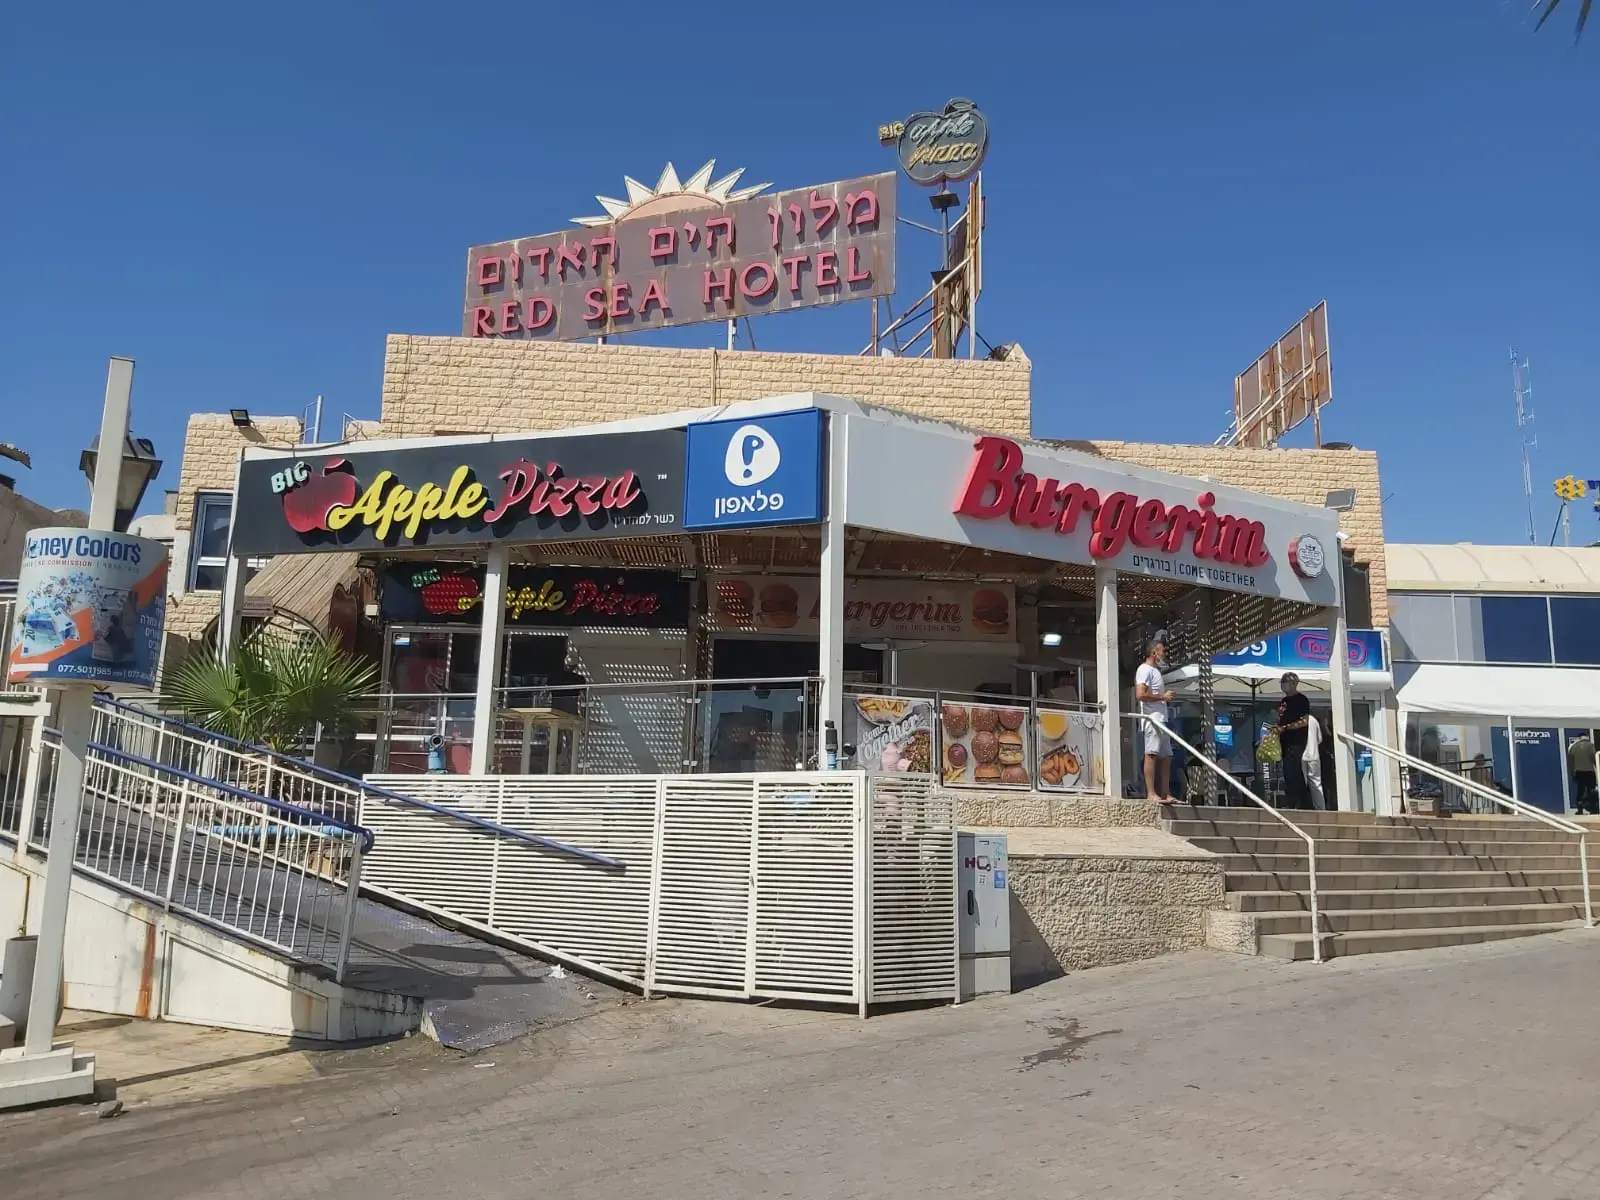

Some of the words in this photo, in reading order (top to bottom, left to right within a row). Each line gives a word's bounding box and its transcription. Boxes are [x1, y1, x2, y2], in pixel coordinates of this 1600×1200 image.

[648, 217, 736, 260] הים
[767, 188, 880, 250] מלון
[477, 234, 616, 288] האדום
[472, 296, 554, 338] RED
[583, 278, 671, 322] SEA
[703, 246, 871, 304] HOTEL
[270, 461, 309, 495] BIG
[328, 465, 489, 541] Apple
[484, 457, 641, 523] Pizza
[653, 513, 675, 524] כשר
[714, 489, 784, 518] פלאפון
[954, 436, 1270, 567] Burgerim
[1133, 555, 1171, 572] בורגרים
[1179, 563, 1204, 578] COME
[1207, 568, 1255, 587] TOGETHER
